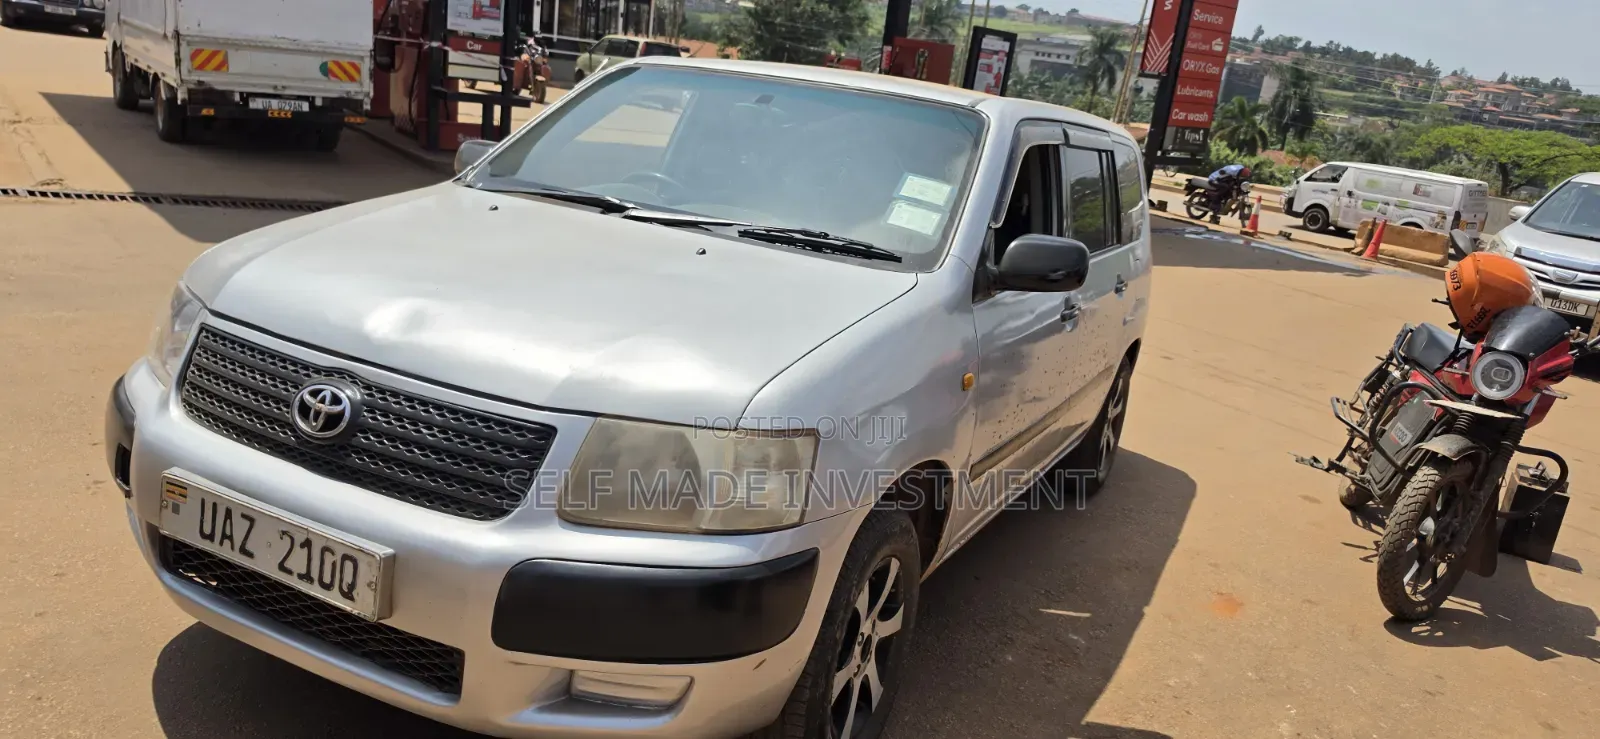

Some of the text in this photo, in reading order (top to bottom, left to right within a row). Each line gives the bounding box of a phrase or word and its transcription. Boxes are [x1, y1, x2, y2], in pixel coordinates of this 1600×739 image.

[1193, 9, 1224, 24] Service
[466, 40, 482, 50] Car
[1182, 59, 1220, 74] ORYX Gas
[1176, 85, 1214, 98] Lubricants
[1171, 108, 1209, 122] Car wash
[198, 497, 360, 604] UAZ 210Q
